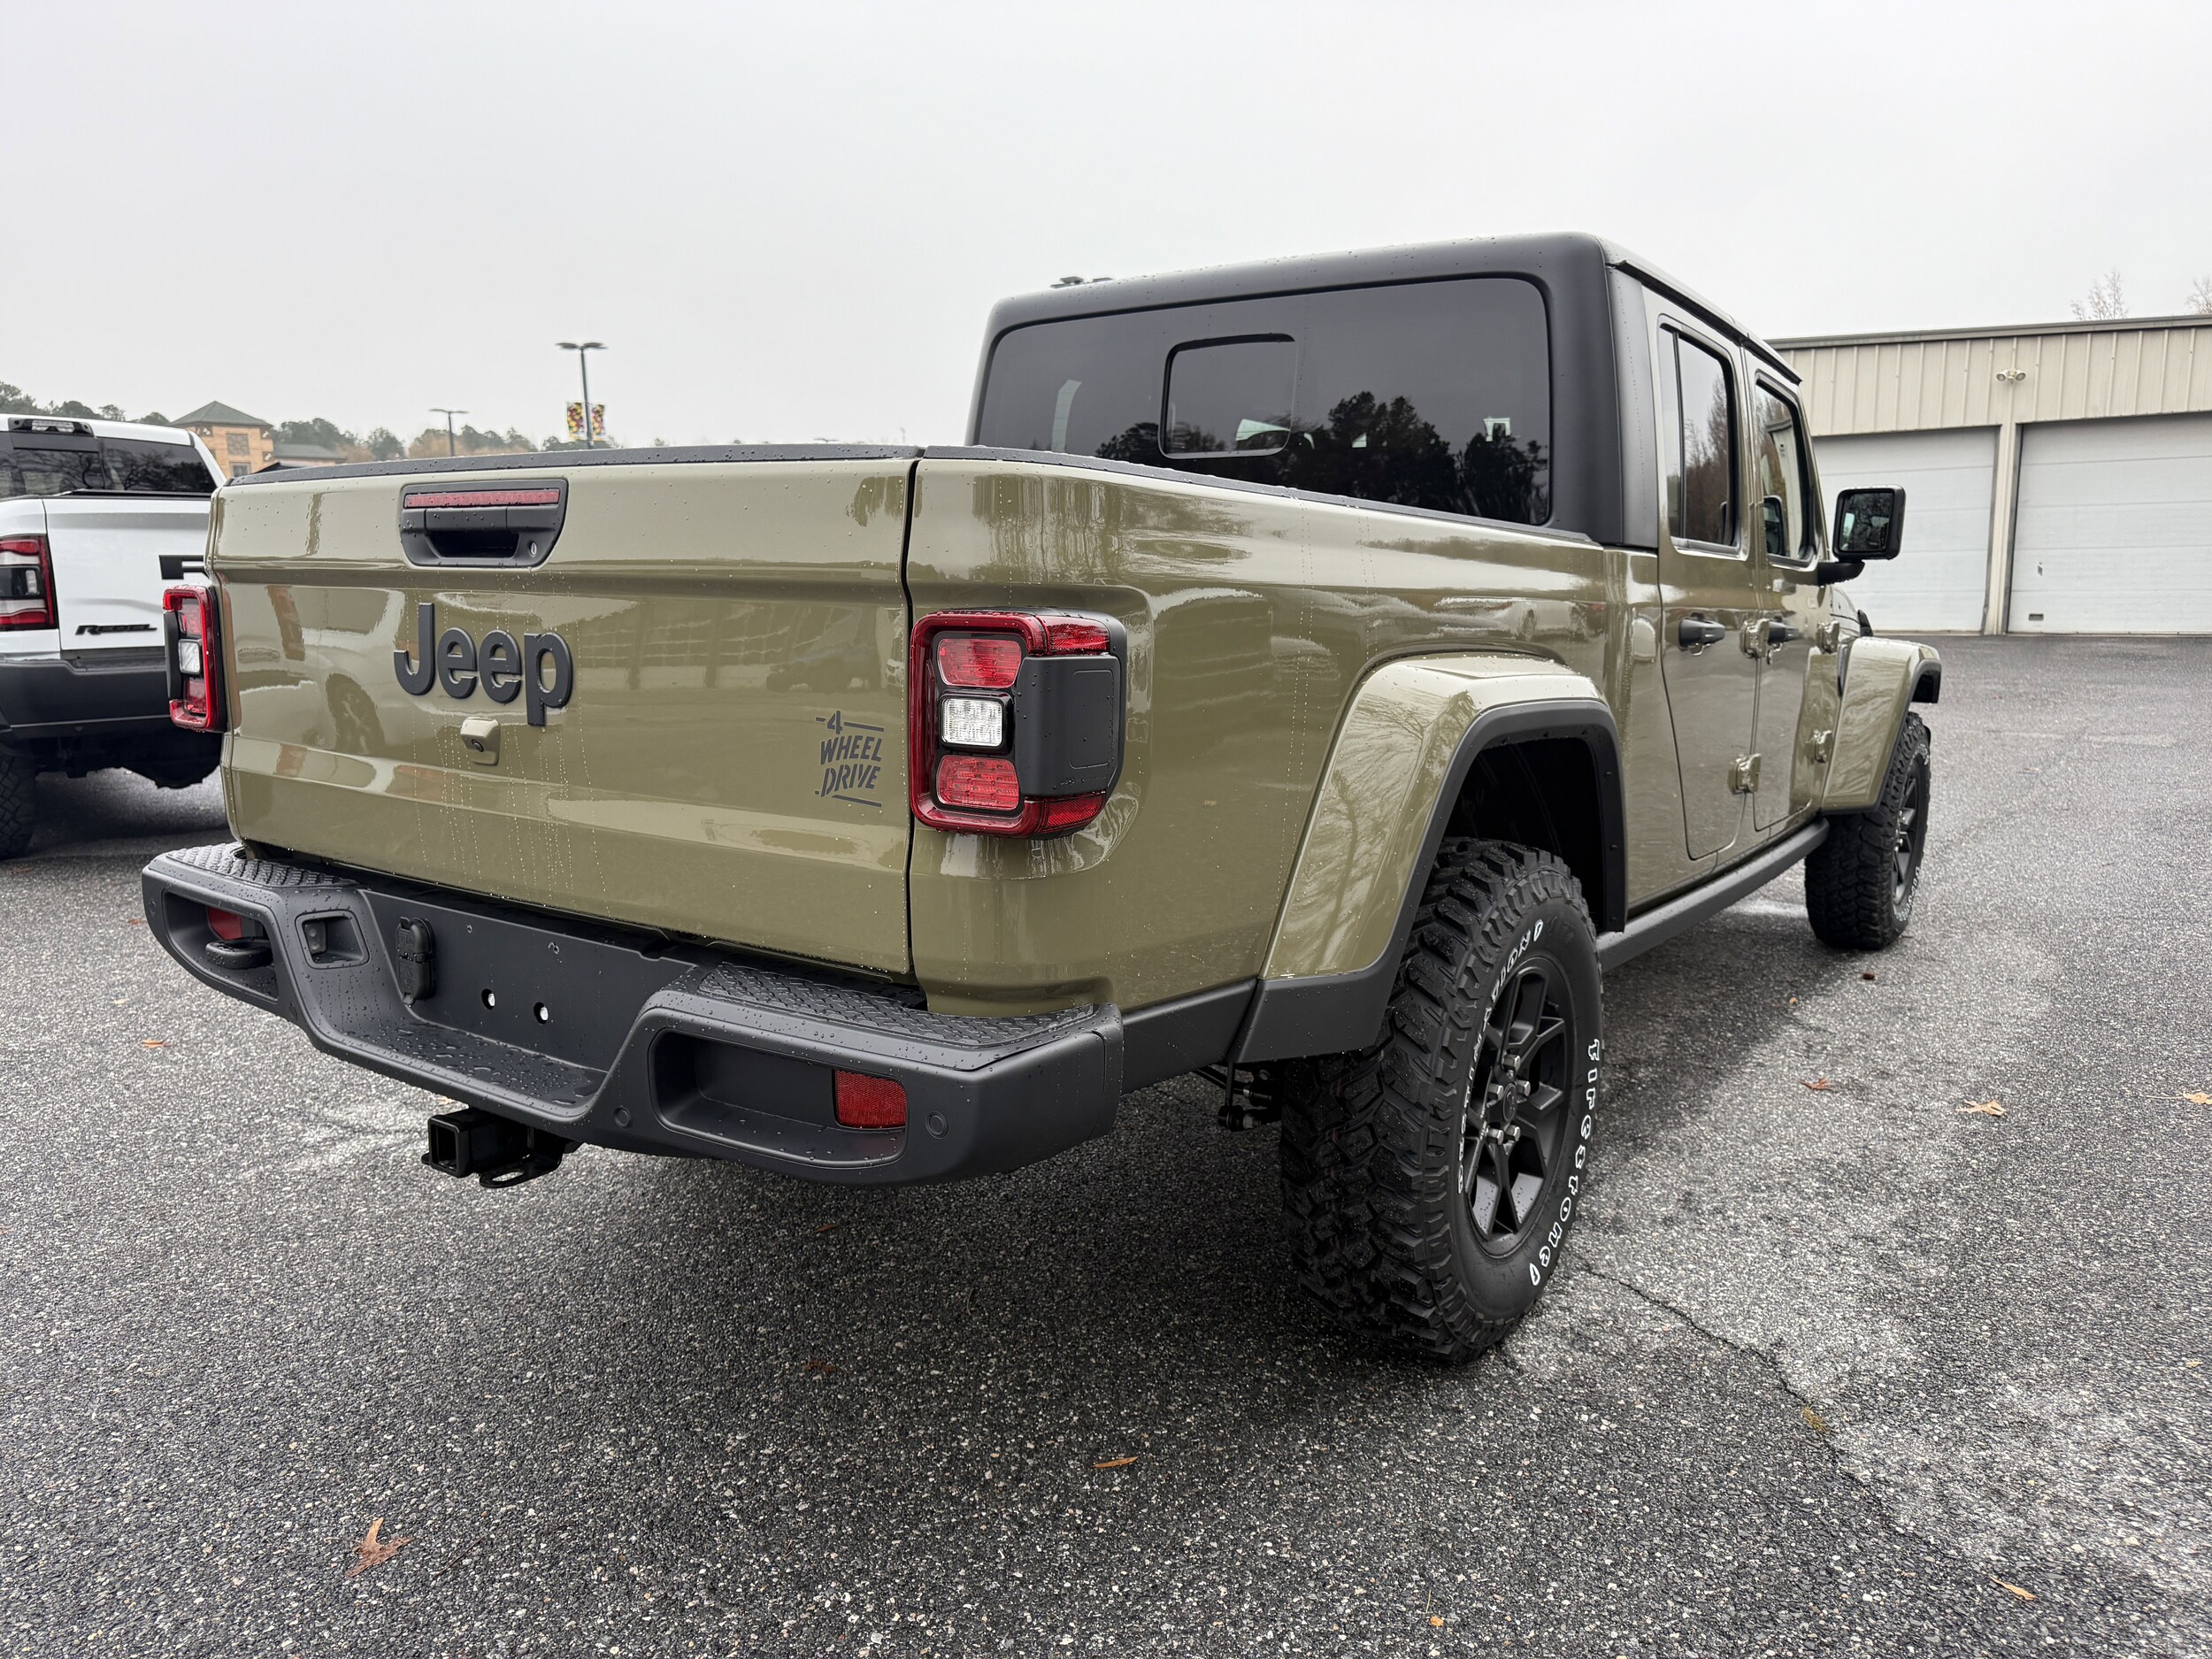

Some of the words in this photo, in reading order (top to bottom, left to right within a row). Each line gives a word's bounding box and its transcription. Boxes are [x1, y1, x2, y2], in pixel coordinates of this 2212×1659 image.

[75, 624, 157, 635] REBEL
[394, 603, 573, 726] Jeep
[827, 710, 842, 734] 4
[820, 735, 882, 765] WHEEL
[821, 764, 880, 797] DRIVE
